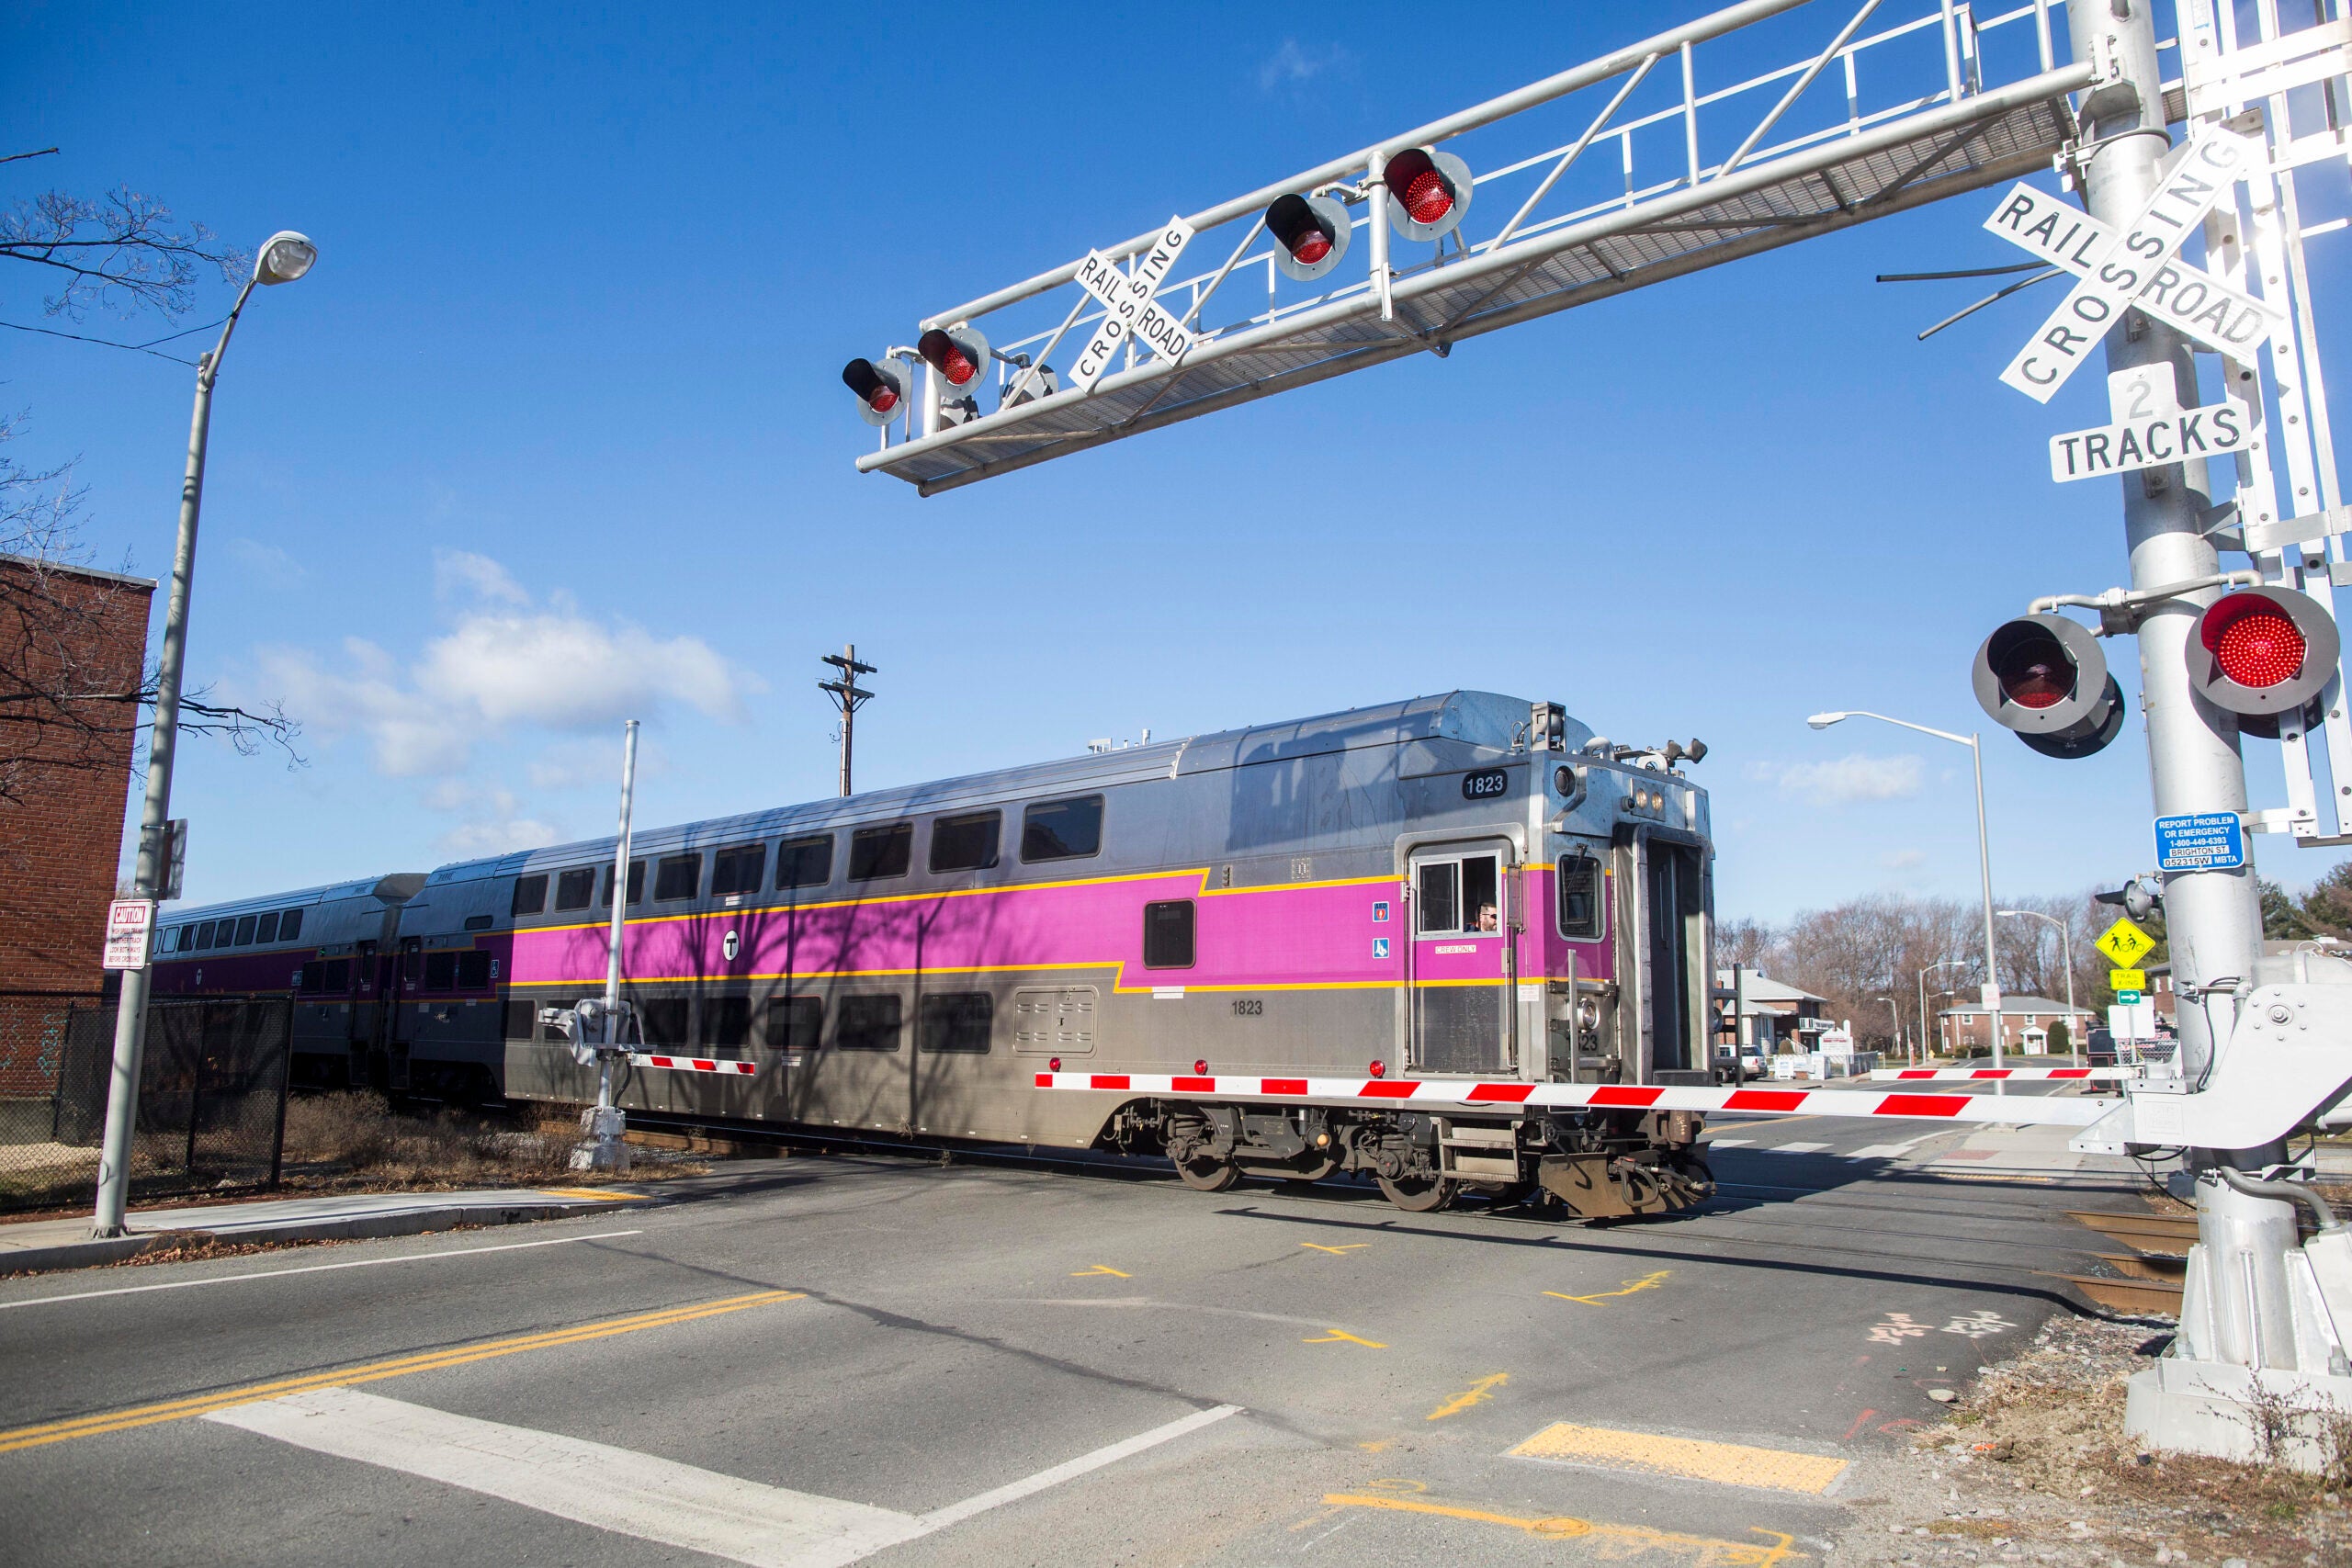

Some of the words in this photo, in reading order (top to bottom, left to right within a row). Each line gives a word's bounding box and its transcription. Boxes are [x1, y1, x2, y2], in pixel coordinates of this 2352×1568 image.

[1996, 193, 2100, 270] RAIL
[2140, 266, 2265, 344] ROAD
[2021, 141, 2240, 386] CROSSING
[1080, 230, 1182, 377] CROSSING
[1080, 256, 1120, 304] RAIL
[1137, 307, 1185, 356] ROAD
[2125, 379, 2154, 420] 2
[2058, 408, 2241, 476] TRACKS
[1466, 774, 1503, 795] 1823
[2159, 818, 2191, 829] REPORT
[2193, 816, 2234, 827] PROBLEM
[2178, 827, 2230, 837] EMERGENCY
[2169, 837, 2227, 847] 1-800-449-6393
[2171, 847, 2214, 857] BRIGHTON
[2214, 855, 2237, 864] MBTA
[115, 907, 145, 923] CAUTION
[726, 938, 737, 956] T
[1231, 1000, 1263, 1015] 1823
[1566, 1033, 1598, 1052] 123
